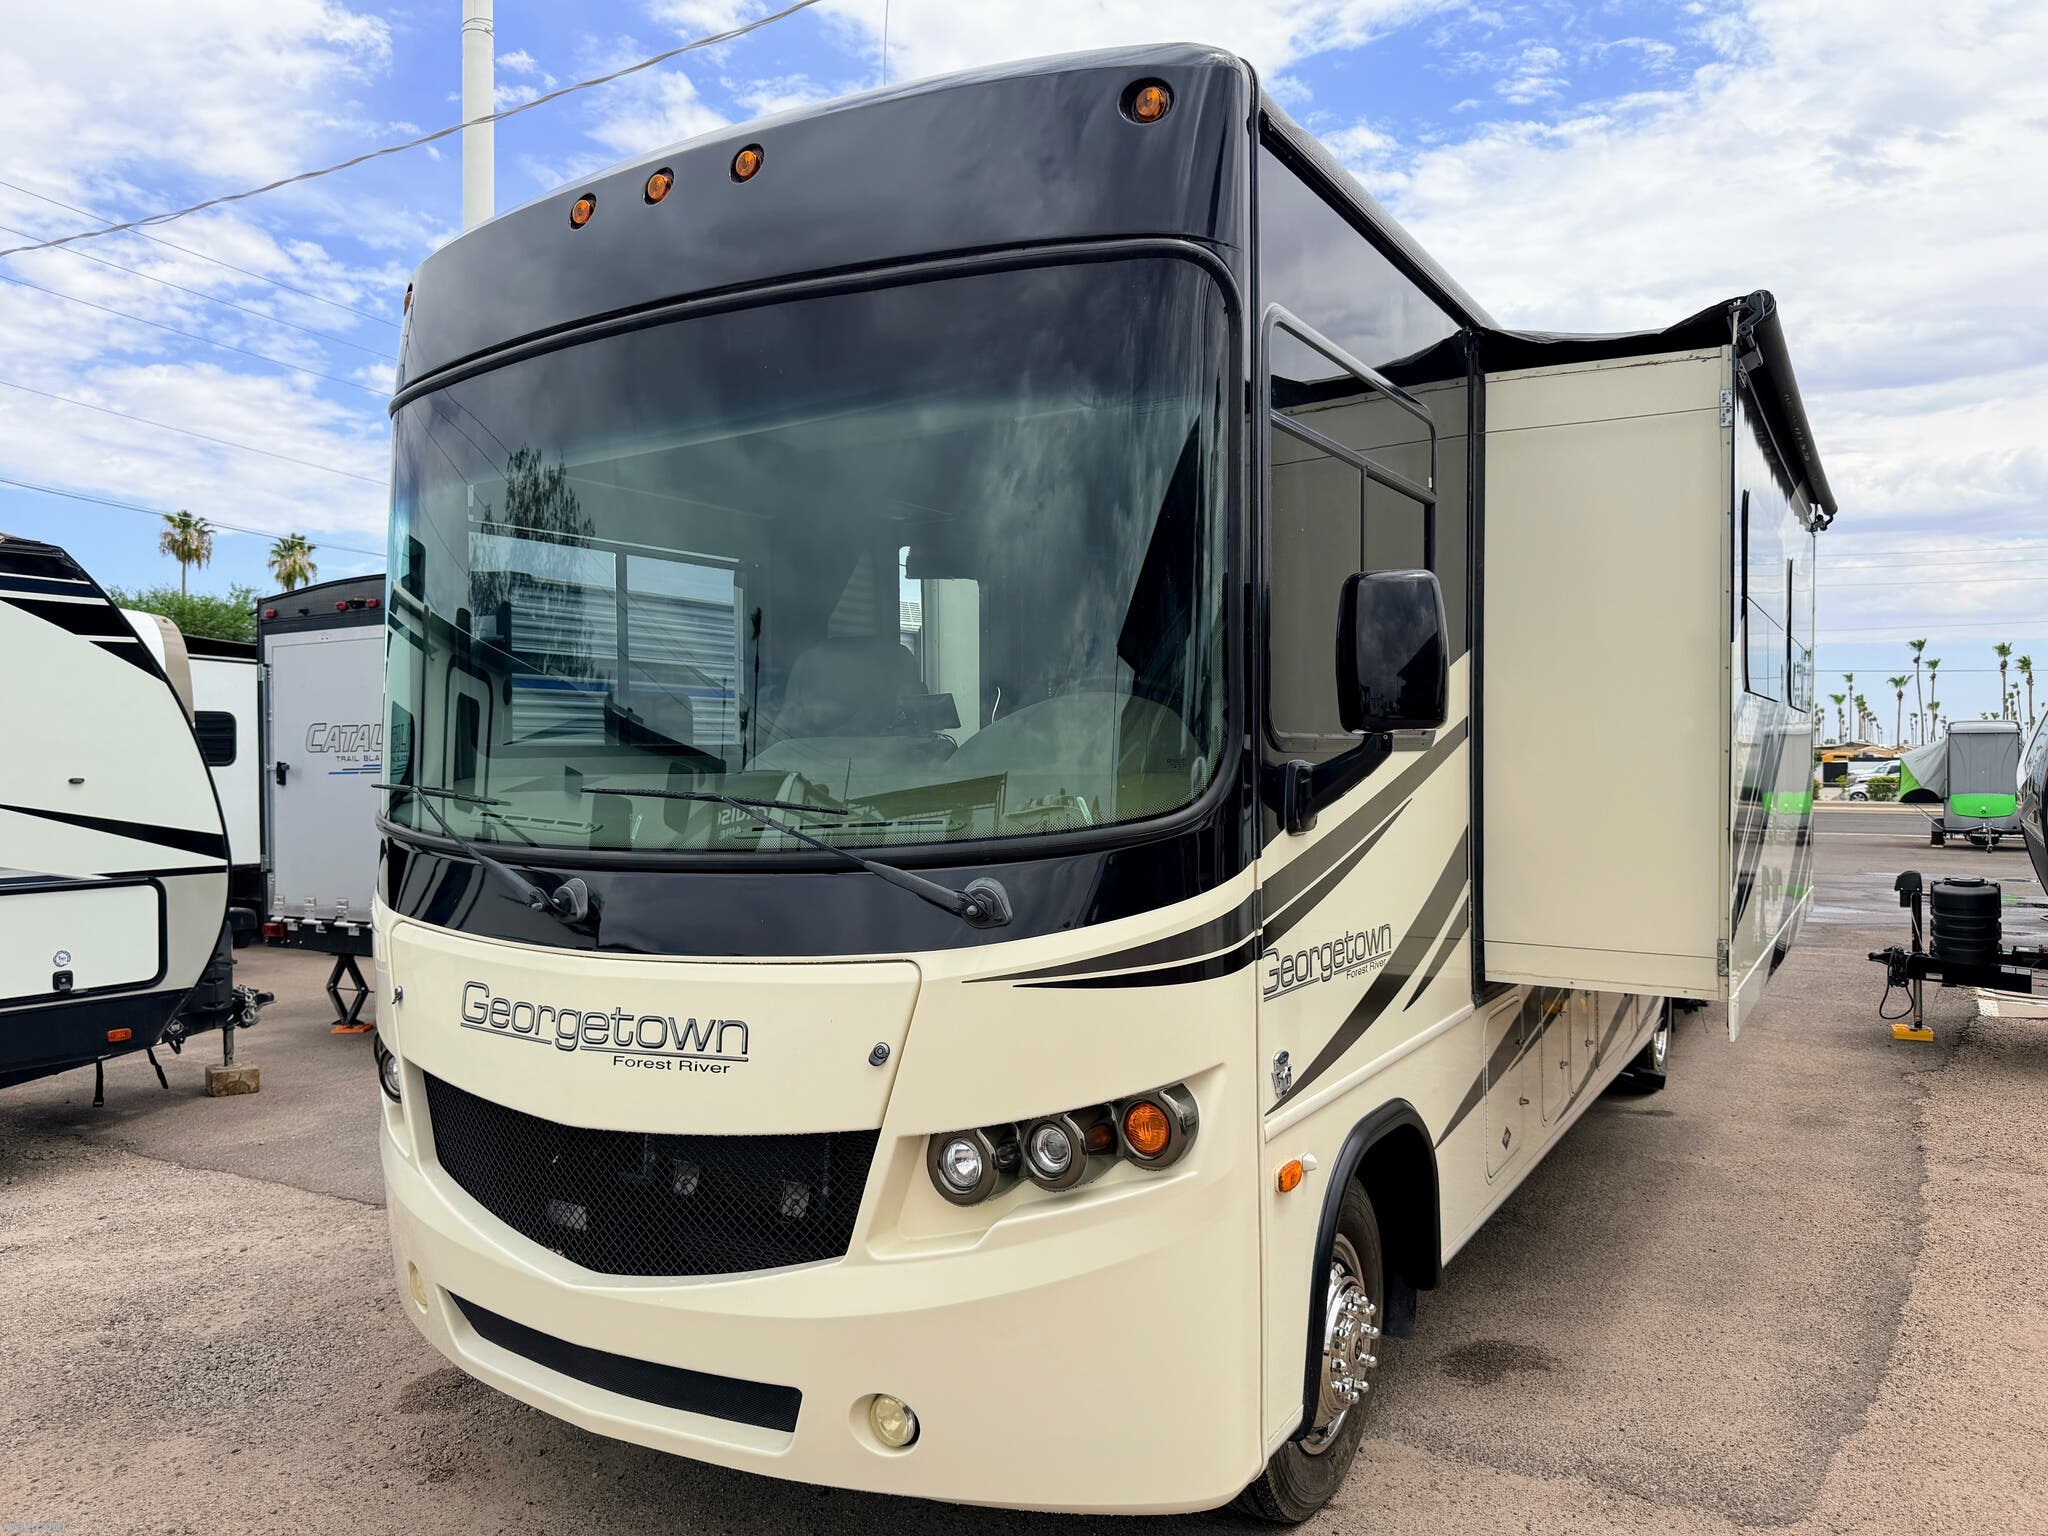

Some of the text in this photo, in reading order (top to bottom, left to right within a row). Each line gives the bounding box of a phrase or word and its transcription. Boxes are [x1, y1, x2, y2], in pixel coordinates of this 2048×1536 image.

[305, 722, 383, 753] CATAL
[1263, 923, 1392, 996] Georgetown
[1346, 959, 1387, 980] Forest River
[460, 980, 750, 1056] Georgetown
[613, 1055, 730, 1075] Forest River
